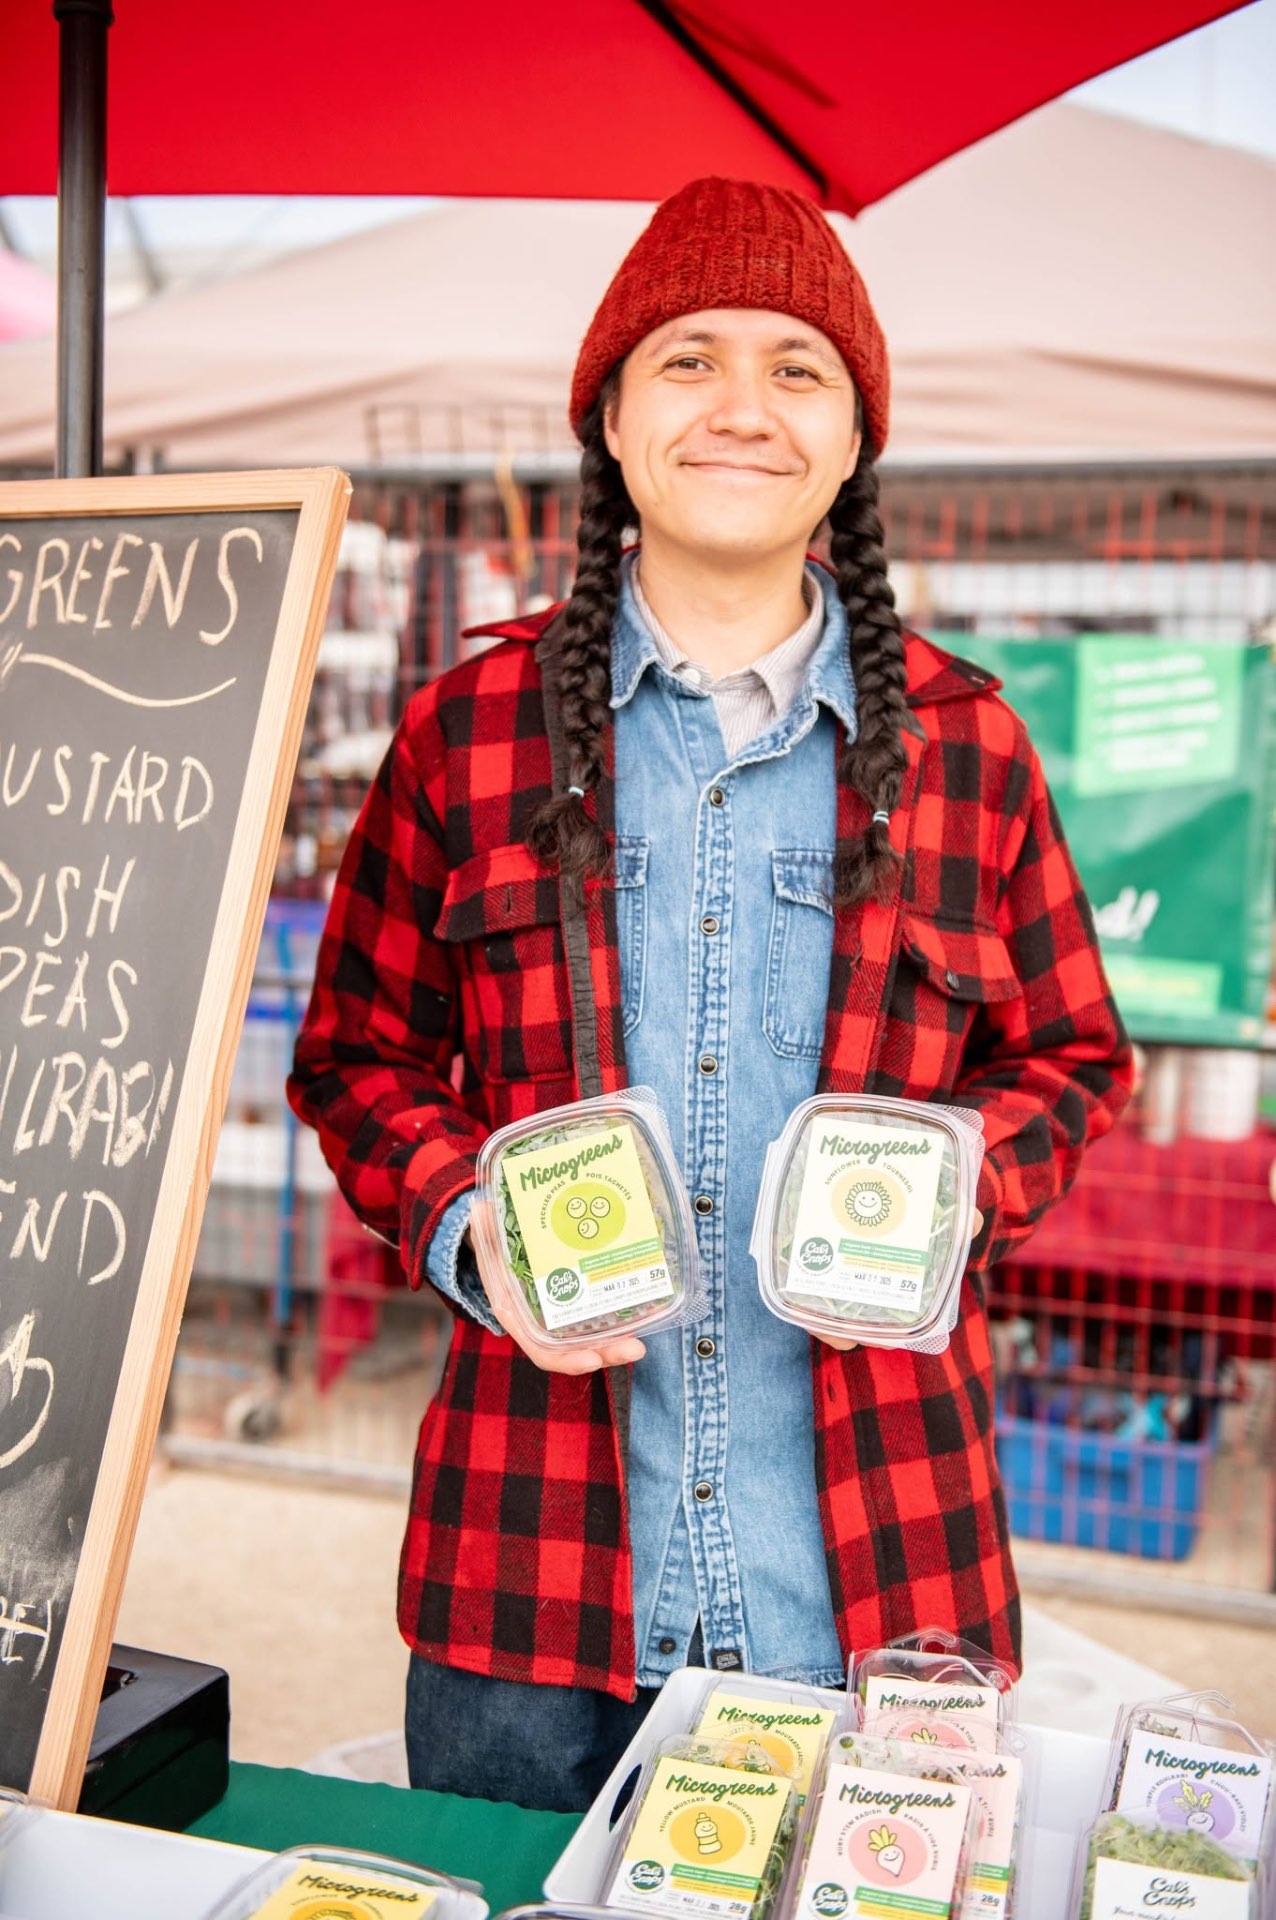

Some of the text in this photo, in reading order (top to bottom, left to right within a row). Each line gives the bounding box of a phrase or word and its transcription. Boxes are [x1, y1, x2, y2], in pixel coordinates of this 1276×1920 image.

[519, 1133, 622, 1191] Microgreens
[820, 1135, 932, 1165] Microgreens
[824, 1159, 861, 1185] SUNFLOWER
[540, 1194, 552, 1229] SPECKLED
[551, 1180, 566, 1194] PEAS
[650, 1269, 666, 1279] 57g
[900, 1280, 917, 1293] 57g
[717, 1706, 823, 1731] Microgreens
[1145, 1748, 1261, 1780] Microgreens
[665, 1774, 778, 1801] Microgreens
[1156, 1773, 1188, 1787] KOHLRABI
[839, 1783, 956, 1815] Microgreens
[659, 1811, 673, 1832] YELLOW
[673, 1797, 706, 1811] MUSTARD
[727, 1800, 754, 1825] MOUTARDE
[855, 1809, 882, 1820] RADISH
[297, 1874, 419, 1903] Microgreens
[981, 1894, 1000, 1906] 28g
